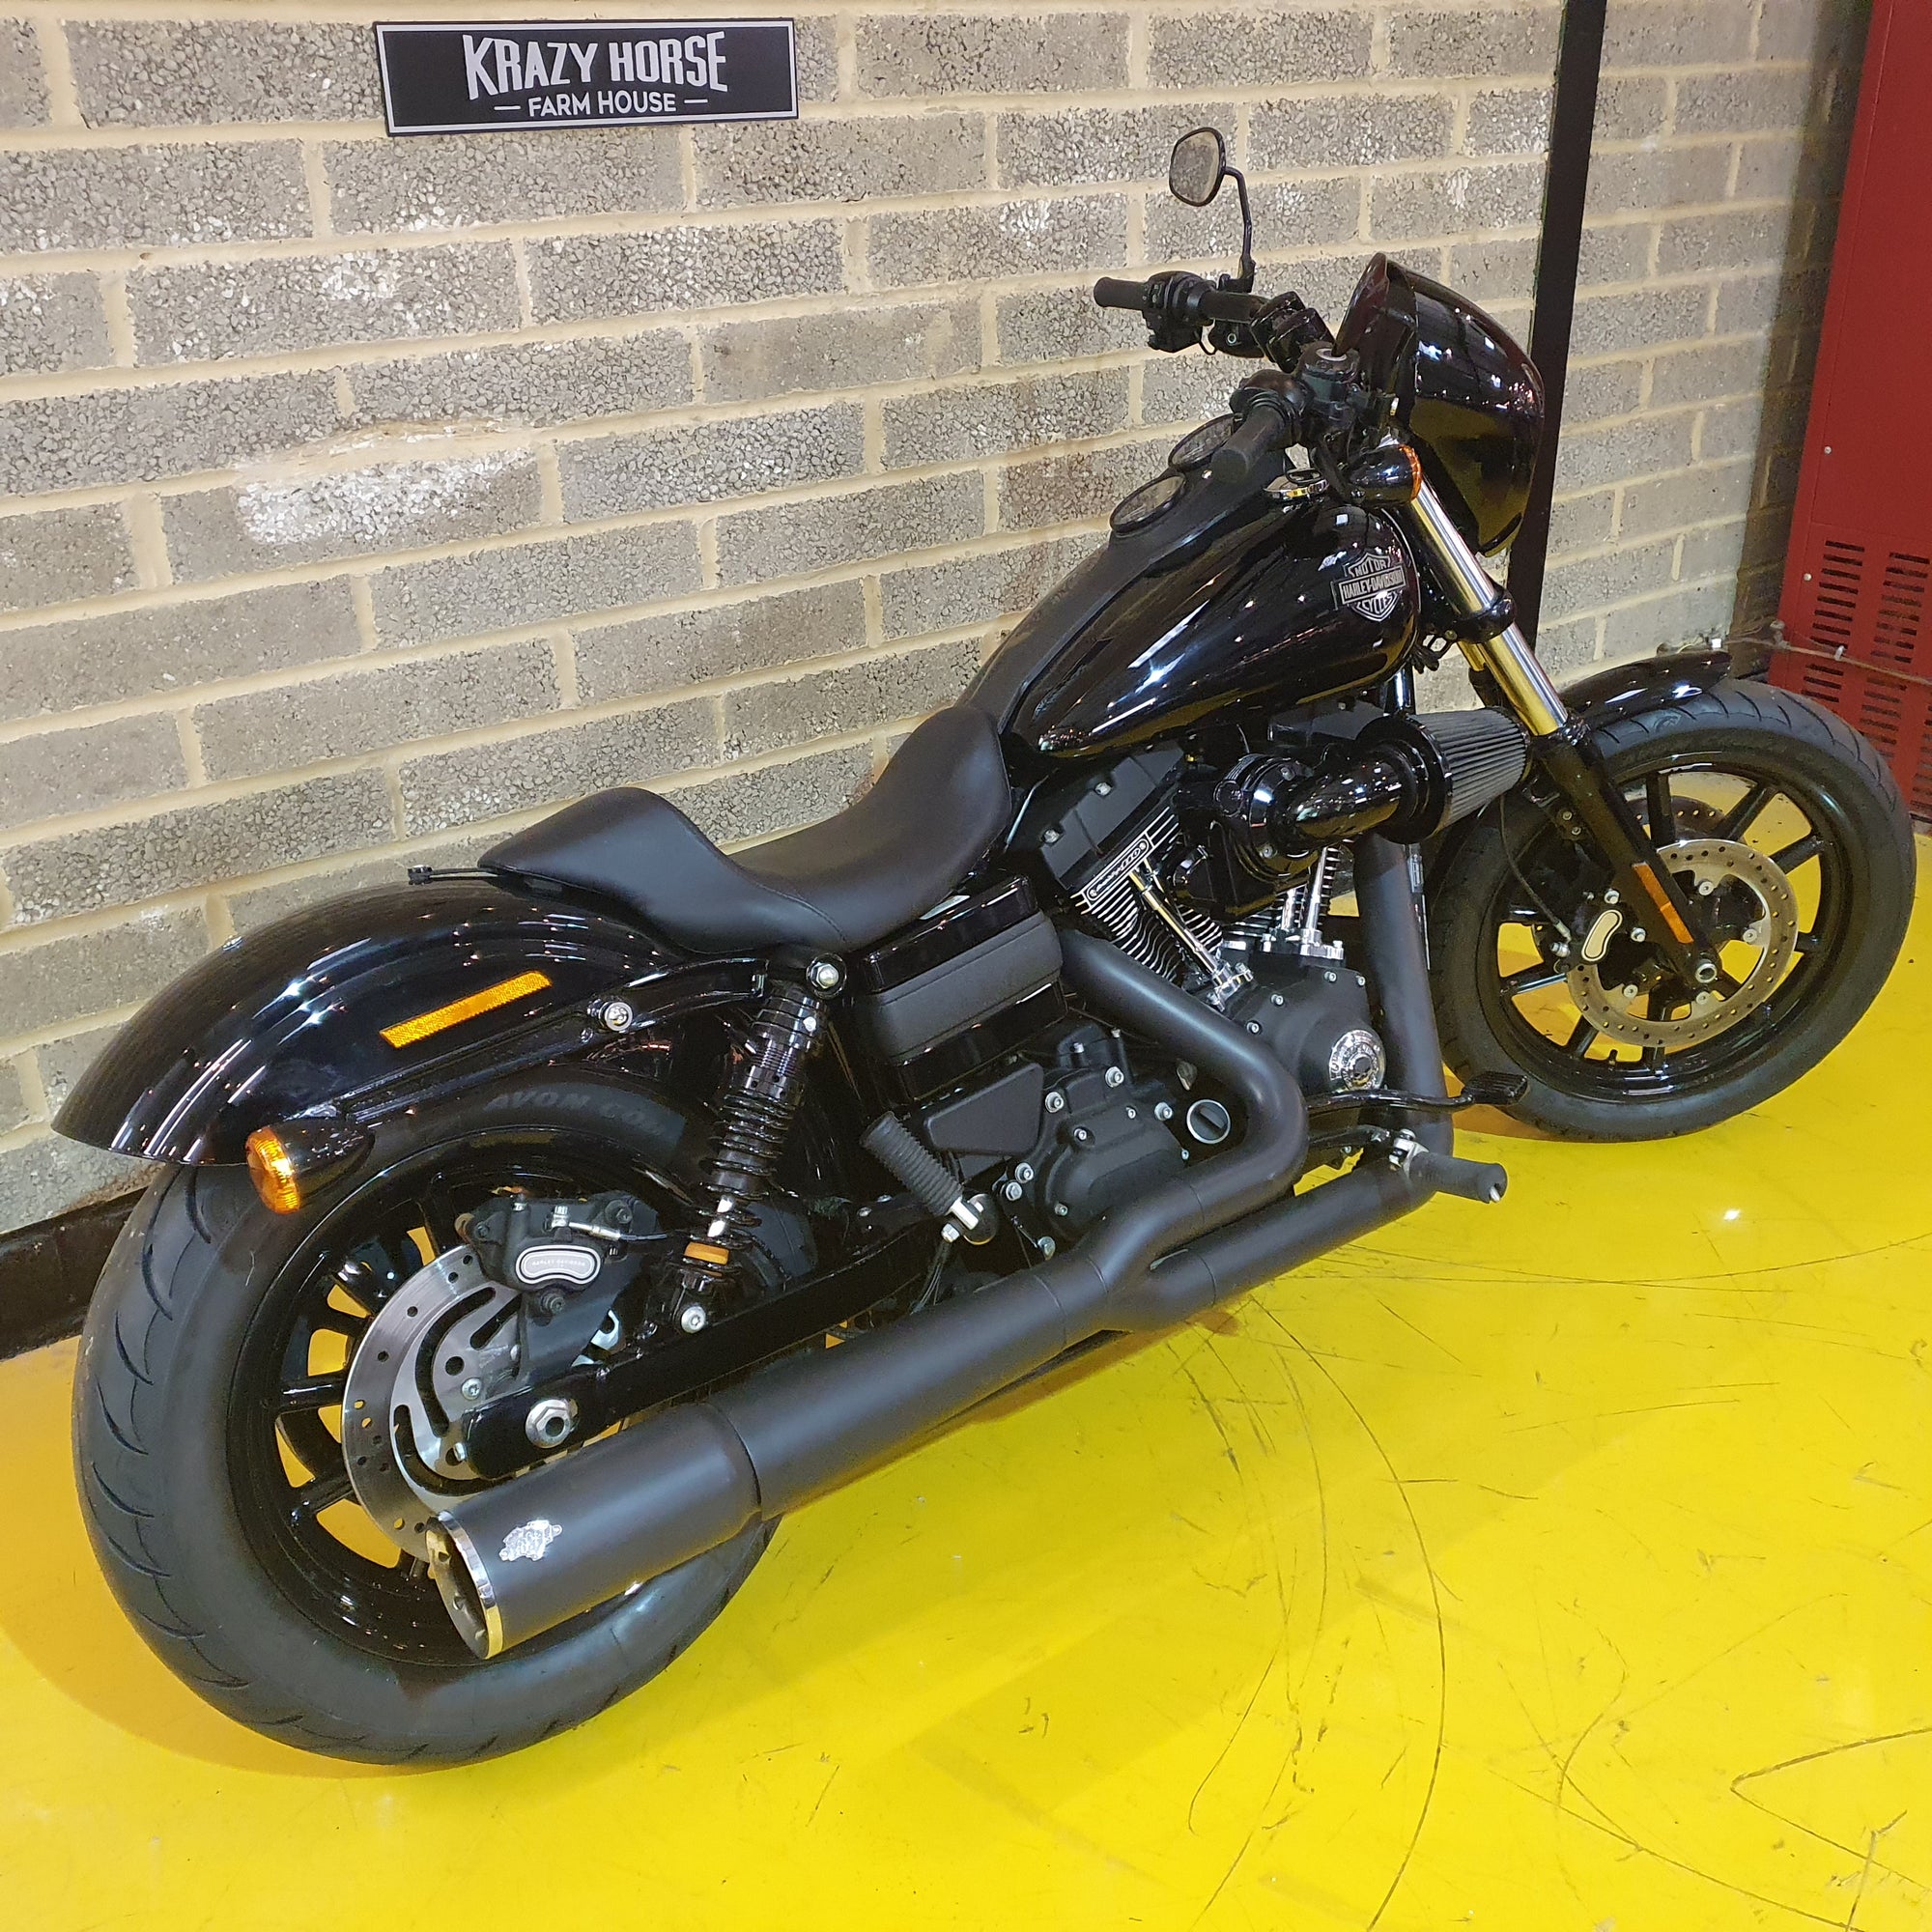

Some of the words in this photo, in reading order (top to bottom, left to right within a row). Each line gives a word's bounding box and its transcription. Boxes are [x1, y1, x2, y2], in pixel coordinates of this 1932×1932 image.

[462, 34, 599, 100] KRAZY
[608, 31, 728, 93] HORSE
[527, 92, 591, 117] FARM
[597, 90, 677, 115] HOUSE
[1354, 557, 1387, 577] MOTOR
[1342, 569, 1404, 600] HARLEY-DAVIDSON
